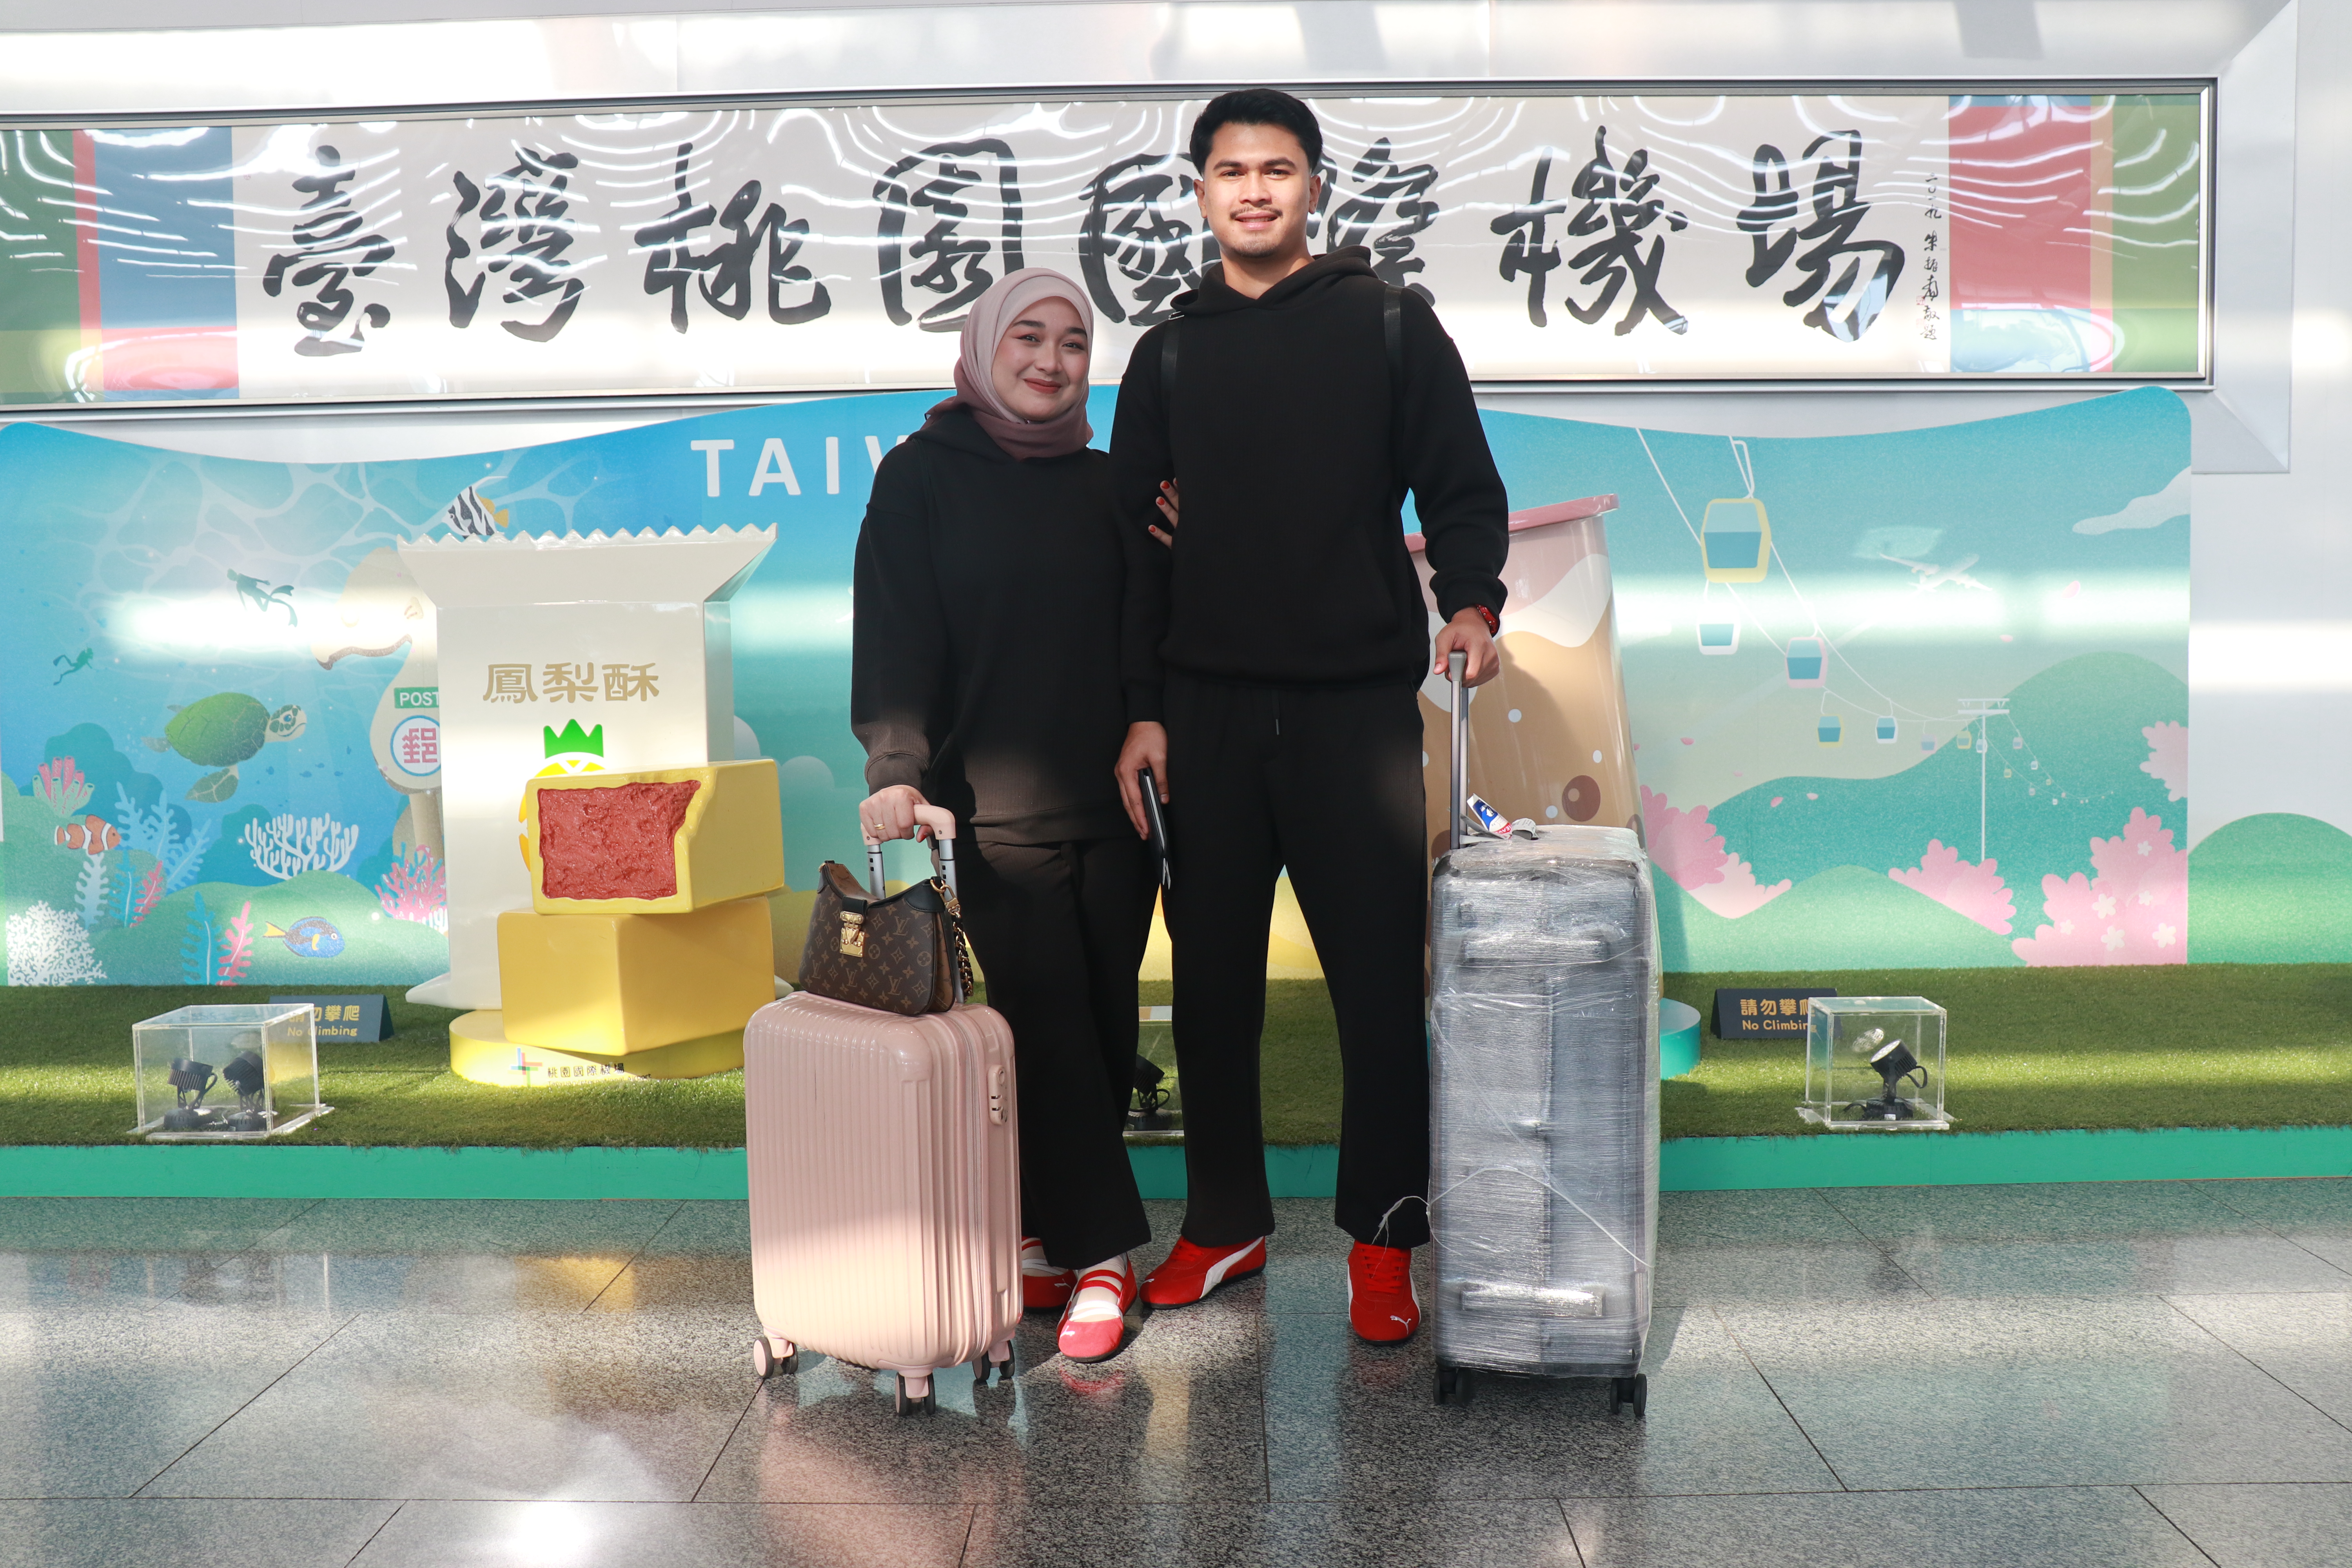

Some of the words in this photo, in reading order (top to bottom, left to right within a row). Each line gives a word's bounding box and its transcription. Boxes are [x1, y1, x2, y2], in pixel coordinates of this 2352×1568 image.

[483, 661, 659, 704] 鳳梨酥
[399, 691, 439, 706] POST
[401, 728, 437, 763] 郵
[287, 1026, 302, 1036] No
[1742, 1020, 1759, 1030] No
[548, 1062, 624, 1078] 桃園國際機場
